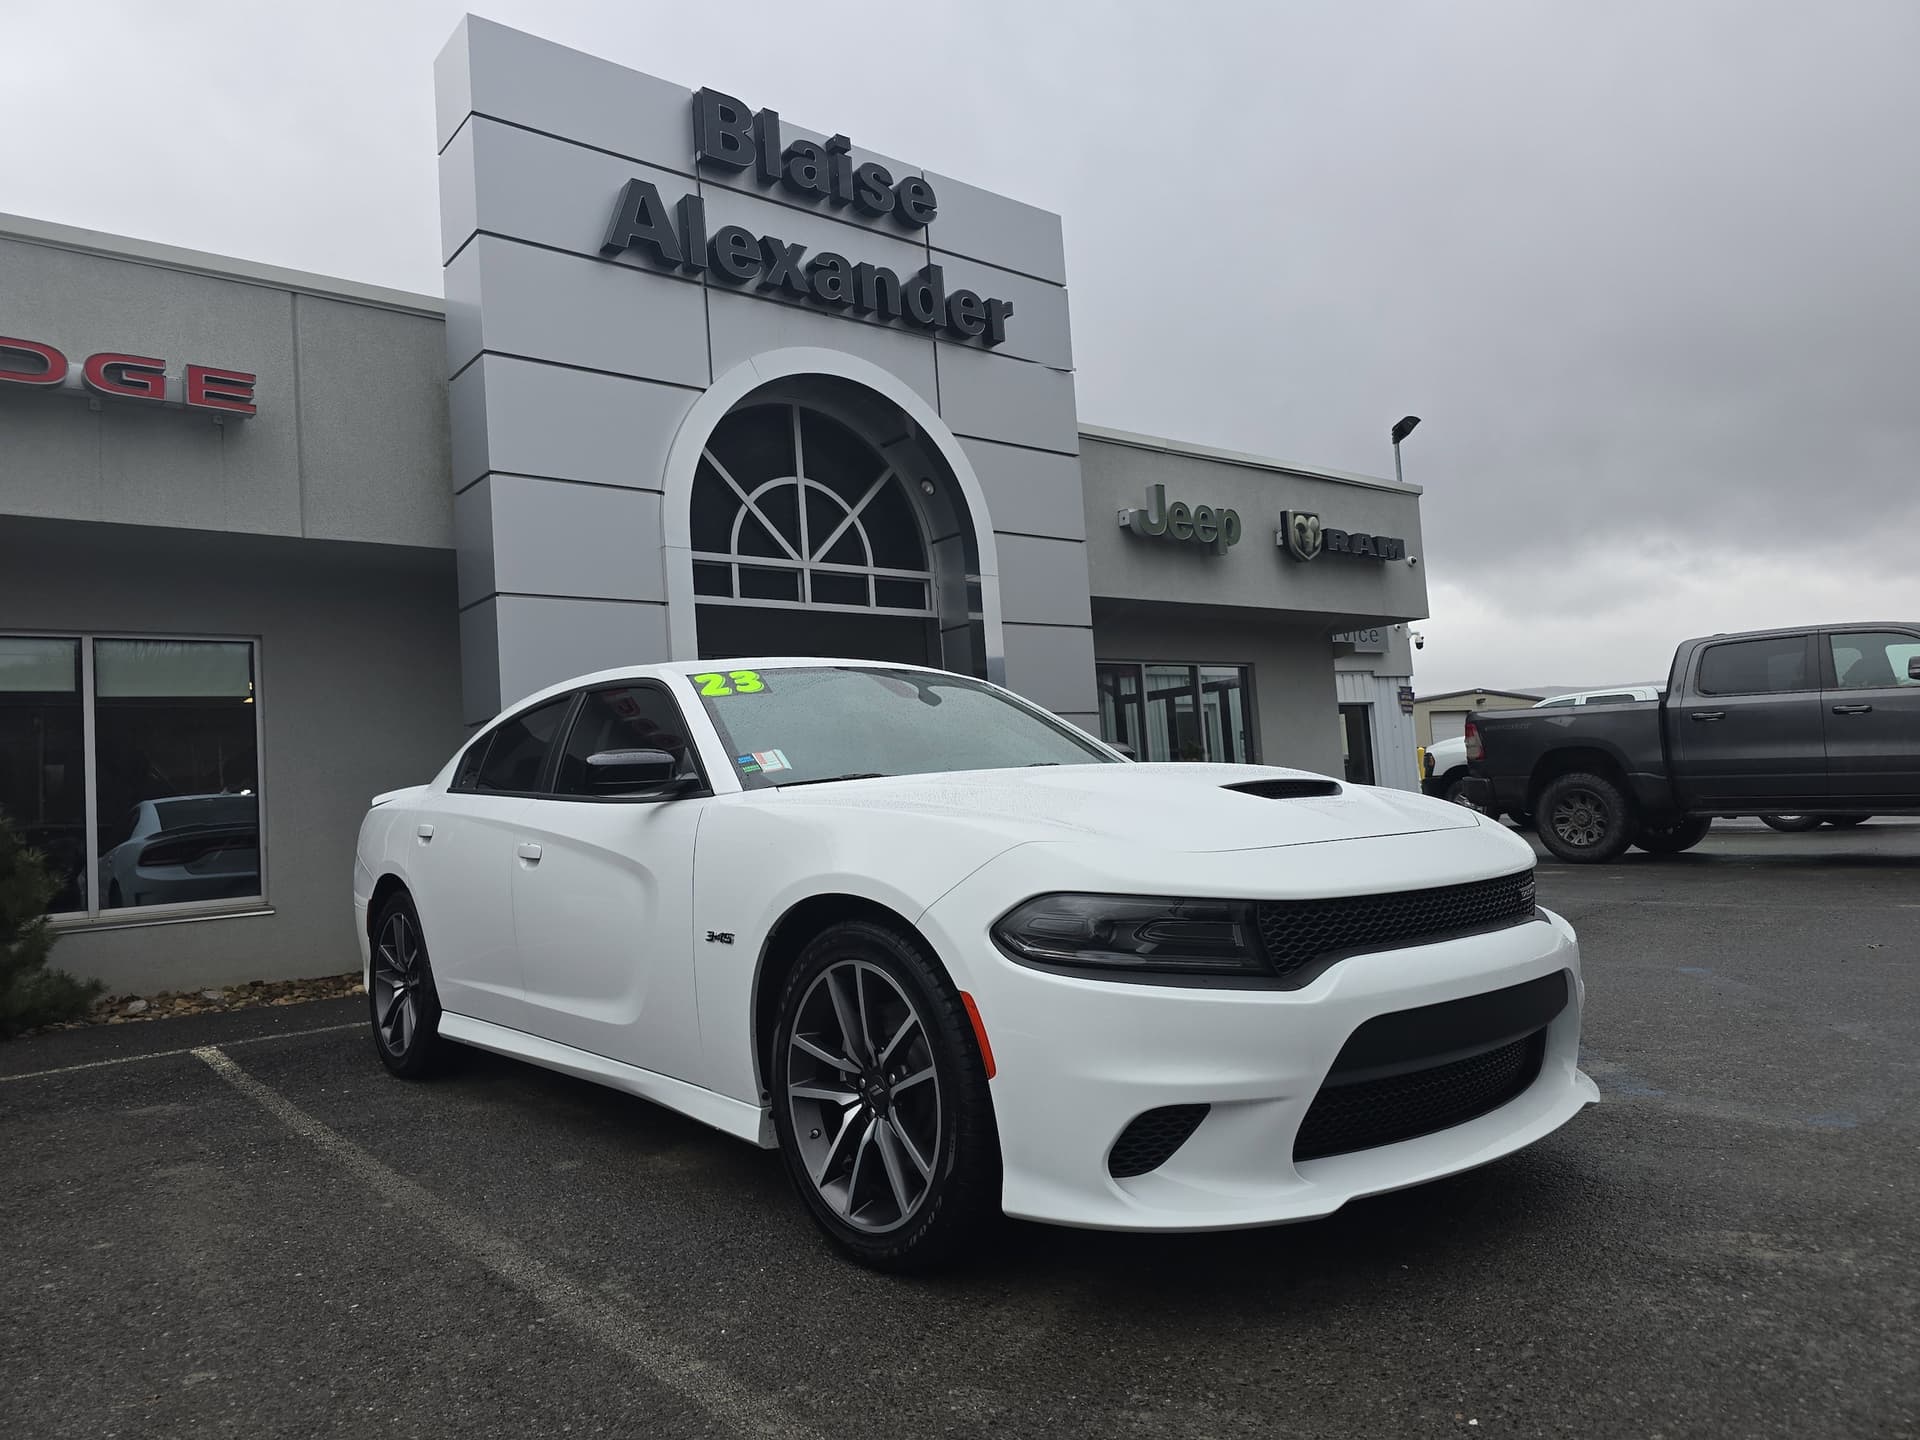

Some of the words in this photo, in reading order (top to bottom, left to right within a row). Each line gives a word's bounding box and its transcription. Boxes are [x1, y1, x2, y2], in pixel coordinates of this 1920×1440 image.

[692, 86, 937, 230] Blaise
[600, 178, 1013, 347] Alexander
[1130, 484, 1241, 555] Jeep
[1321, 528, 1405, 560] RAM
[694, 670, 765, 697] 23
